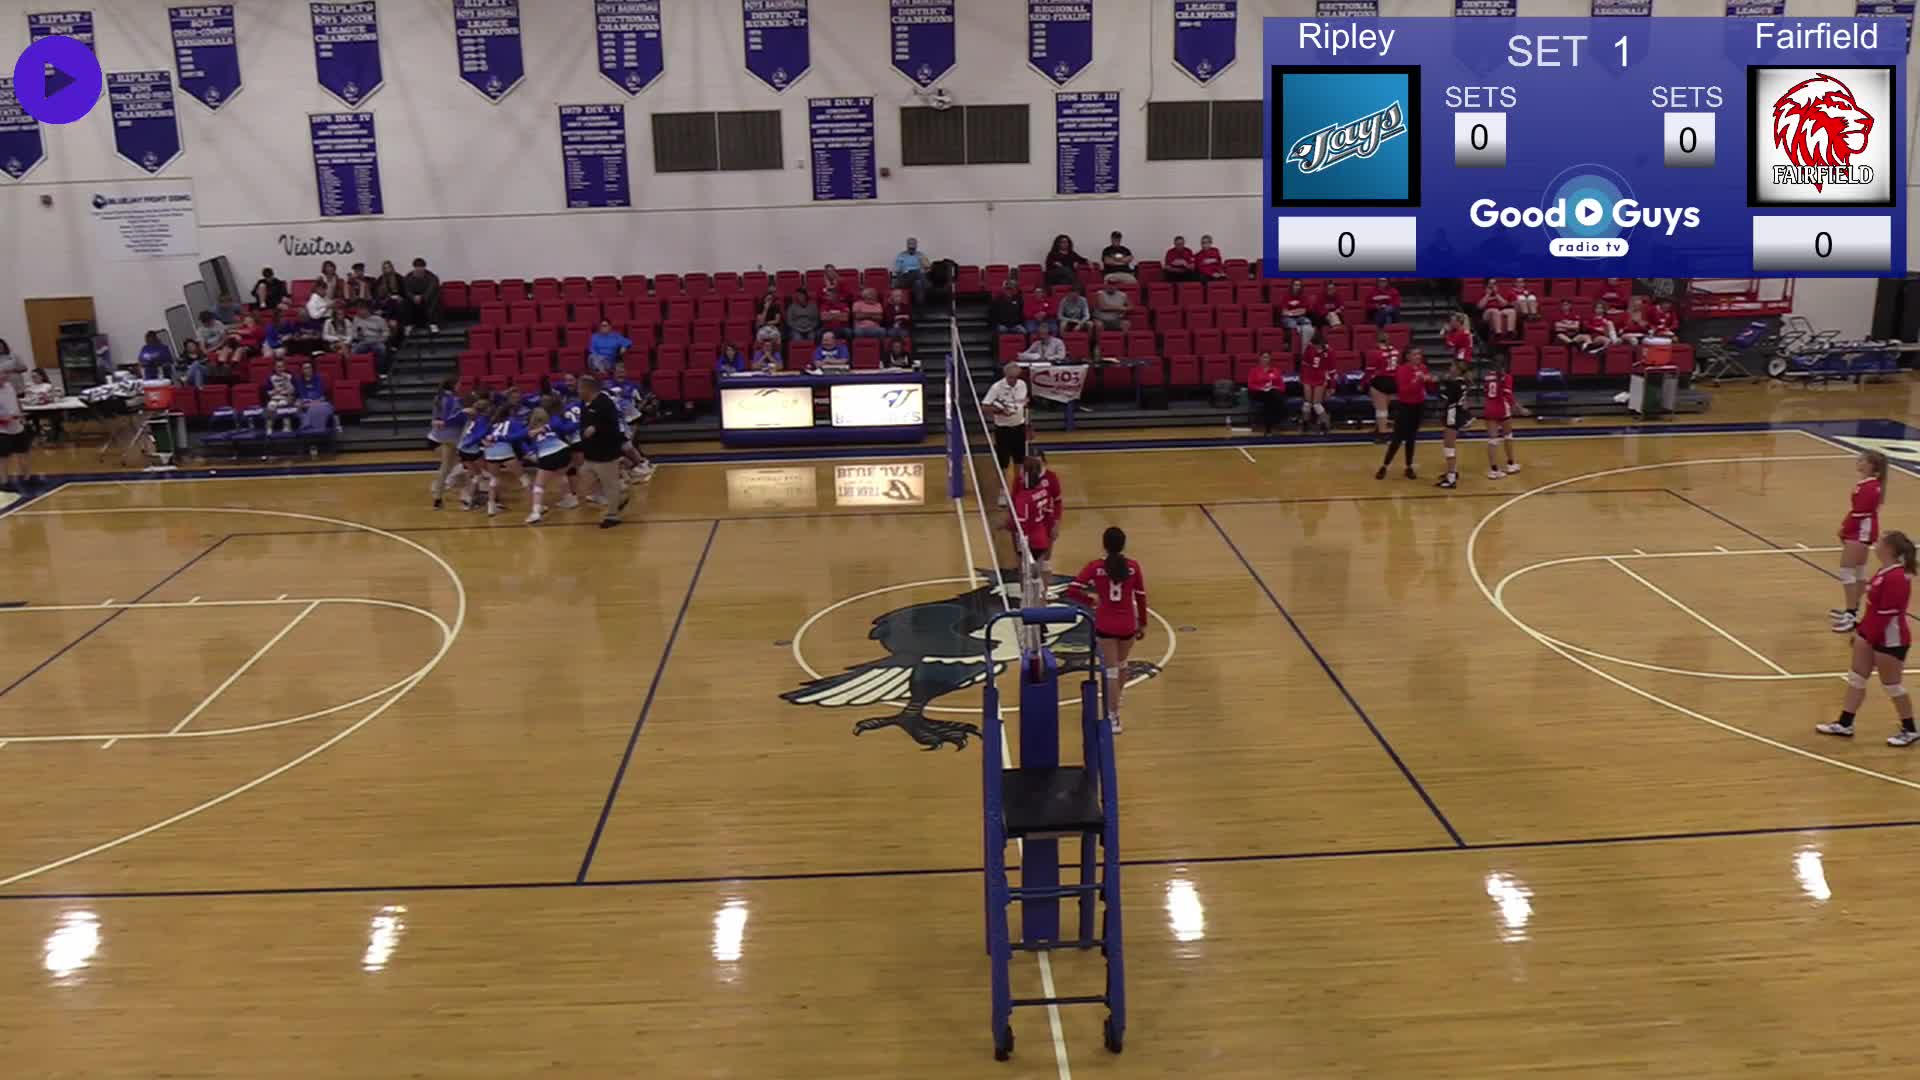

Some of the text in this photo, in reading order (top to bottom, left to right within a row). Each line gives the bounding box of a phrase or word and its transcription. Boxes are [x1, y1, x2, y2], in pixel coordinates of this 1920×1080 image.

[898, 7, 946, 16] DISTRICT
[1033, 5, 1087, 13] REGIONAL
[1184, 3, 1225, 11] LEAGUE
[180, 7, 223, 17] RIPLEY
[751, 11, 800, 20] DISTRICT
[1176, 11, 1235, 19] CHAMPIONS
[38, 14, 81, 24] RIPLEY
[599, 14, 658, 23] SECTIONAL
[892, 16, 953, 24] CHAMPIONS
[466, 19, 508, 28] LEAGUE
[598, 23, 659, 31] CHAMPIONS
[324, 25, 367, 34] LEAGUE
[457, 27, 519, 36] CHAMPIONS
[315, 33, 377, 42] CHAMPIONS
[116, 73, 160, 82] RIPLEY
[123, 102, 163, 111] LEAGUE
[115, 109, 174, 118] CHAMPIONS
[278, 234, 355, 257] Visitors
